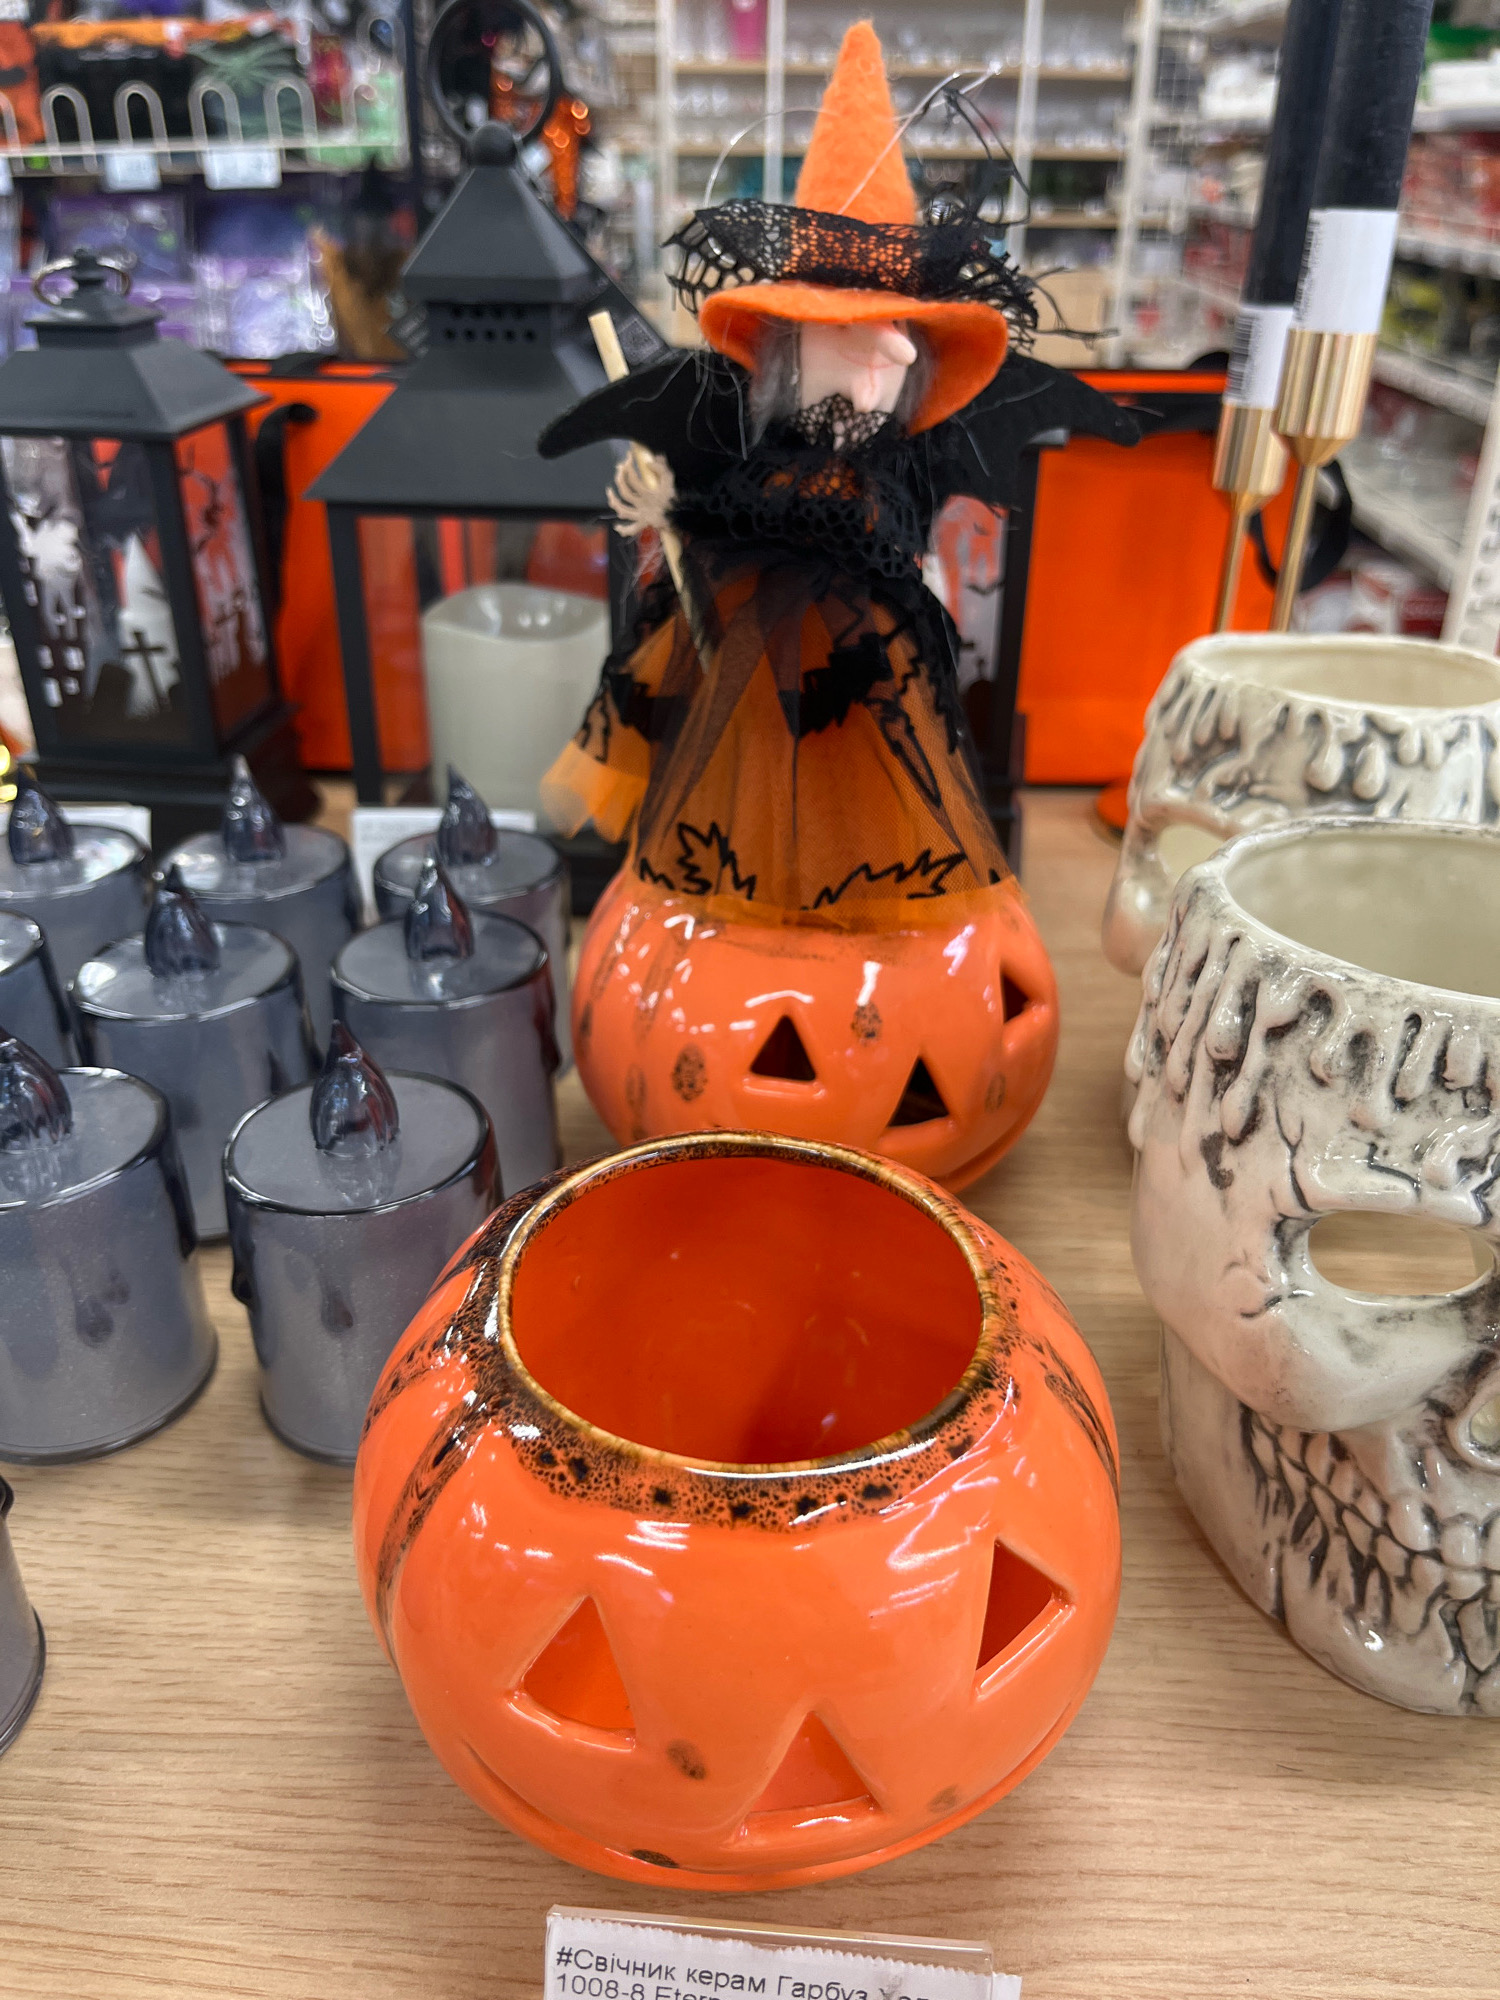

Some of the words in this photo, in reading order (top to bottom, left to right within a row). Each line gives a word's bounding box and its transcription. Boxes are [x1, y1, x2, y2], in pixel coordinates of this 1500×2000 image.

[556, 1946, 677, 1981] #Свічник
[686, 1967, 767, 1994] керам
[556, 1973, 646, 2000] 1008-8
